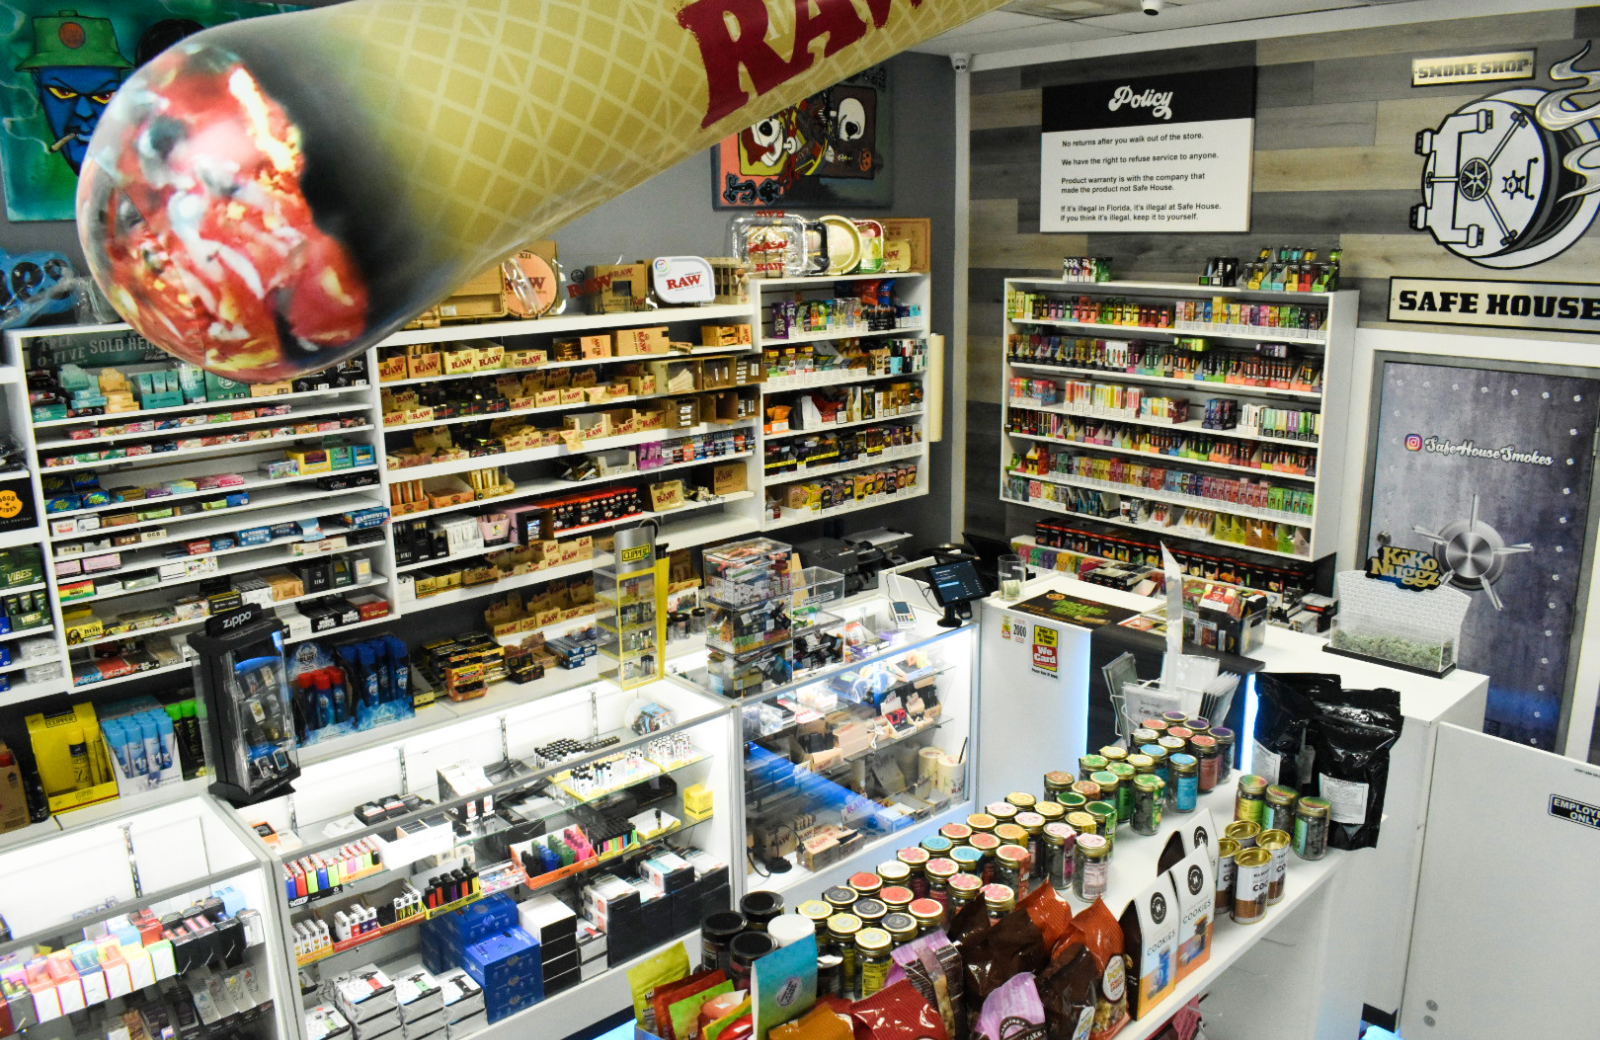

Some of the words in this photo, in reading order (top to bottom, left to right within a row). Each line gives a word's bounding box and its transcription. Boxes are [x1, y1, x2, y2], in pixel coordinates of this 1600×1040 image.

[676, 0, 923, 129] RA
[1417, 62, 1478, 80] SMOKE
[1479, 58, 1530, 75] SHOP
[1108, 85, 1174, 120] Policy
[1115, 138, 1127, 146] you
[1102, 157, 1118, 165] right
[1189, 152, 1219, 160] anyone.
[1088, 176, 1117, 184] warranty
[1156, 174, 1189, 182] company
[1092, 186, 1118, 194] product
[1078, 205, 1097, 213] illegal
[1106, 204, 1132, 212] Florida,
[1146, 204, 1167, 212] illegal
[1109, 214, 1132, 222] illegal,
[1133, 214, 1150, 222] keep
[1166, 213, 1198, 222] yourself.
[505, 276, 545, 291] RW
[666, 274, 701, 290] RAW
[1398, 289, 1480, 314] SAFE
[1486, 293, 1600, 321] HOUSE
[90, 338, 124, 354] SOLD
[128, 337, 157, 351] HER
[451, 357, 472, 370] RAW
[479, 354, 502, 367] RAW
[521, 354, 542, 366] RAW
[380, 365, 404, 378] RAW
[414, 360, 438, 374] RAW
[567, 391, 581, 400] RAW
[612, 387, 626, 396] RAW
[514, 399, 533, 410] RAW
[542, 394, 557, 403] RAW
[385, 413, 403, 425] RAW
[412, 409, 431, 421] RAW
[642, 415, 662, 428] RAW
[585, 426, 603, 438] RAW
[617, 422, 635, 435] RAW
[524, 436, 540, 447] RAW
[0, 495, 16, 503] OOD
[656, 487, 676, 504] RAW
[354, 512, 388, 525] ELEMENTS
[562, 550, 578, 562] RAW
[7, 568, 32, 583] VIBES
[20, 611, 42, 625] VIBES
[541, 612, 559, 625] RAW
[566, 608, 582, 620] RAW
[501, 625, 517, 635] RAW
[1037, 646, 1053, 656] We
[1034, 653, 1056, 664] Card
[1570, 811, 1597, 826] ONLY
[1182, 898, 1212, 925] COOKIES
[1146, 928, 1176, 957] COOKIES
